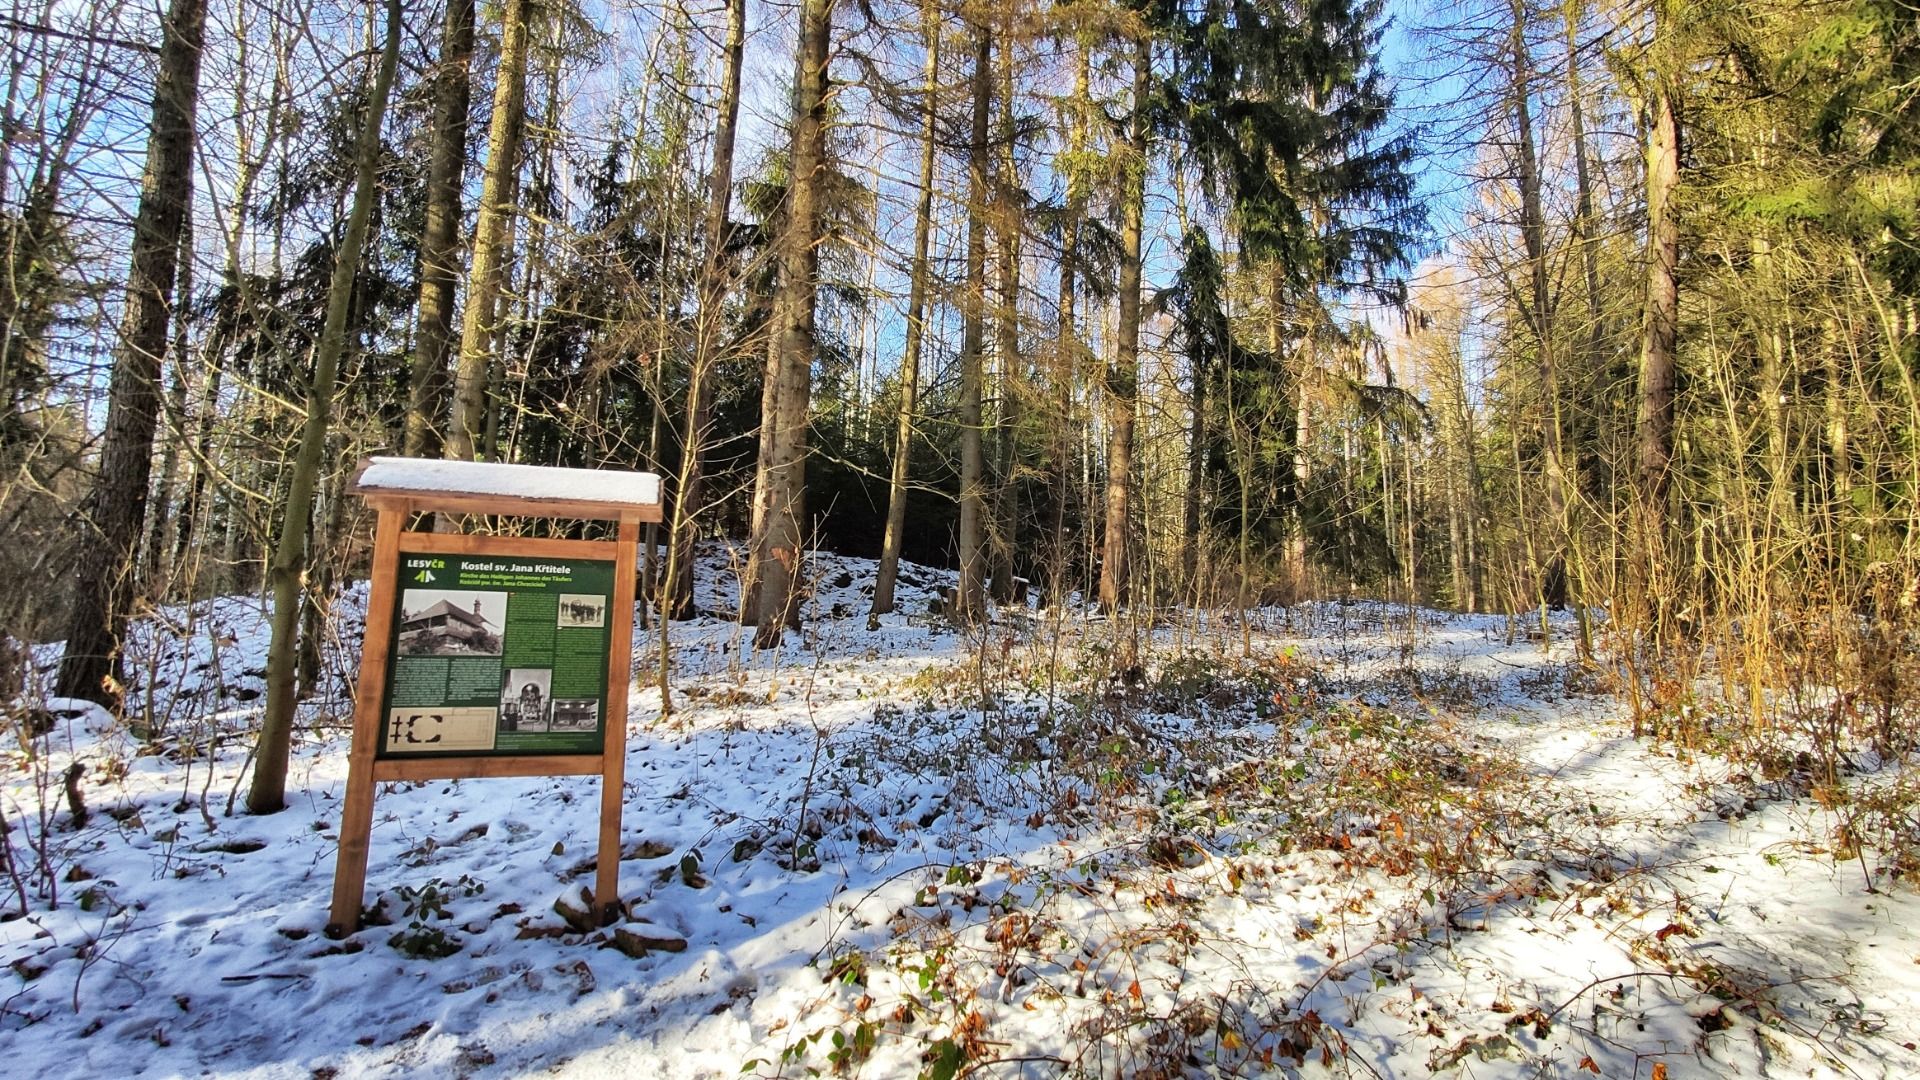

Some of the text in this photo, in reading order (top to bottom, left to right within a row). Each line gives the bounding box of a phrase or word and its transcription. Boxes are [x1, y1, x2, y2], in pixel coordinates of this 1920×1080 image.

[461, 561, 572, 574] Kostel sv. Jana Křtitele
